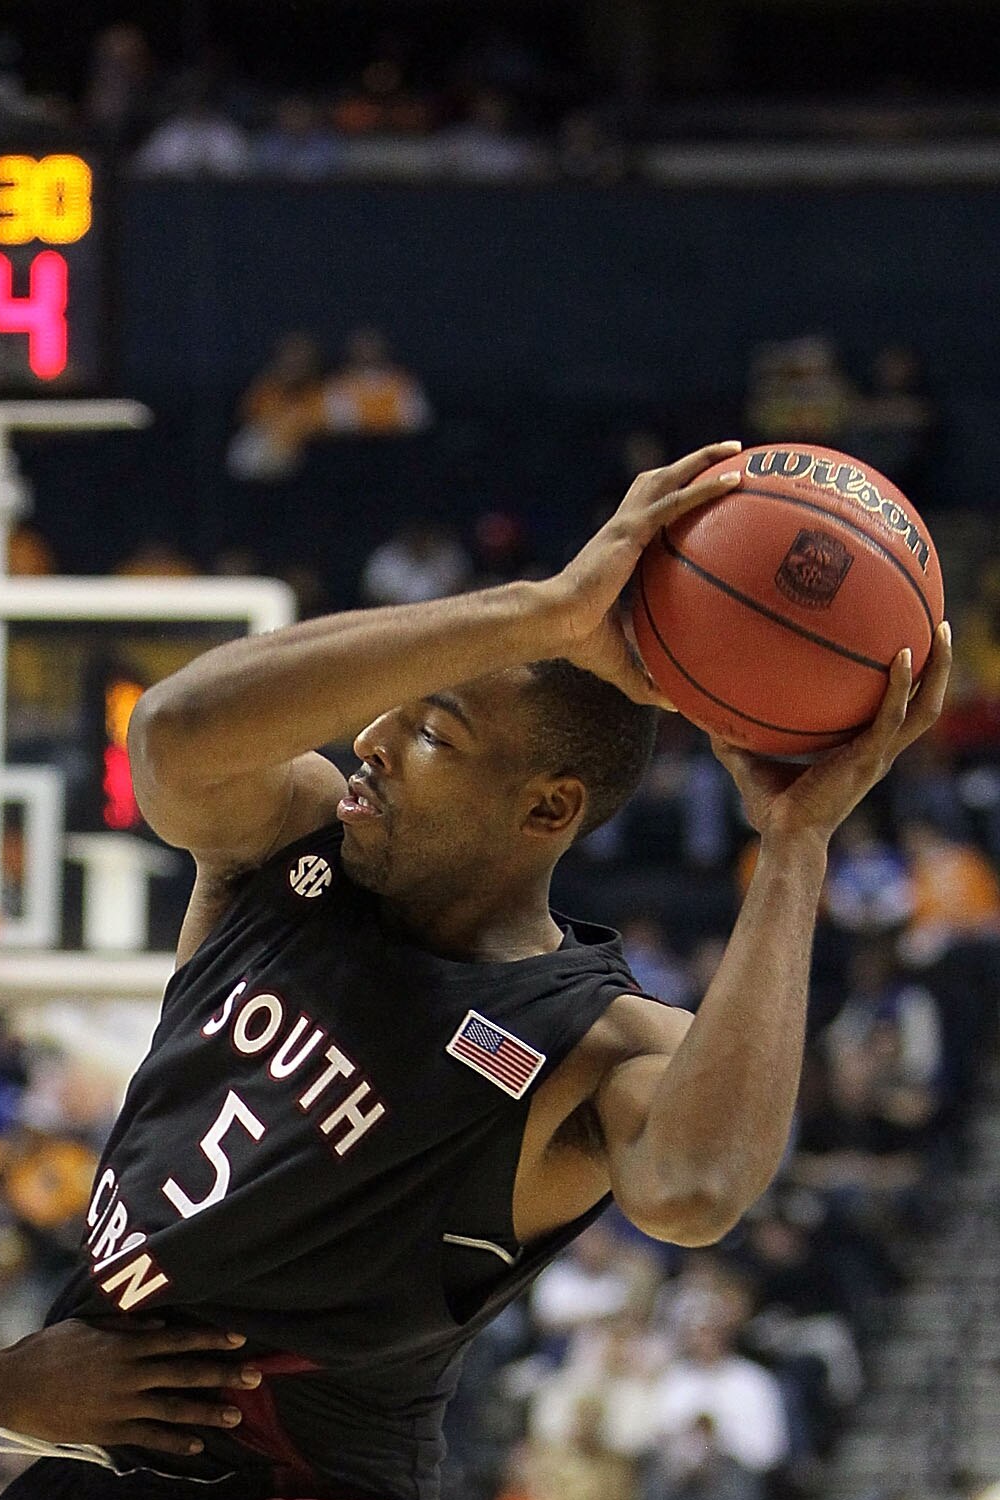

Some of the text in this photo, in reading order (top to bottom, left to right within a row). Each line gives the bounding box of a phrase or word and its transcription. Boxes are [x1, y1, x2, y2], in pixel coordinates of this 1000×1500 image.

[746, 451, 930, 577] Wilson
[289, 855, 332, 898] SEC
[201, 979, 386, 1157] SOUTH
[161, 1088, 266, 1220] 5
